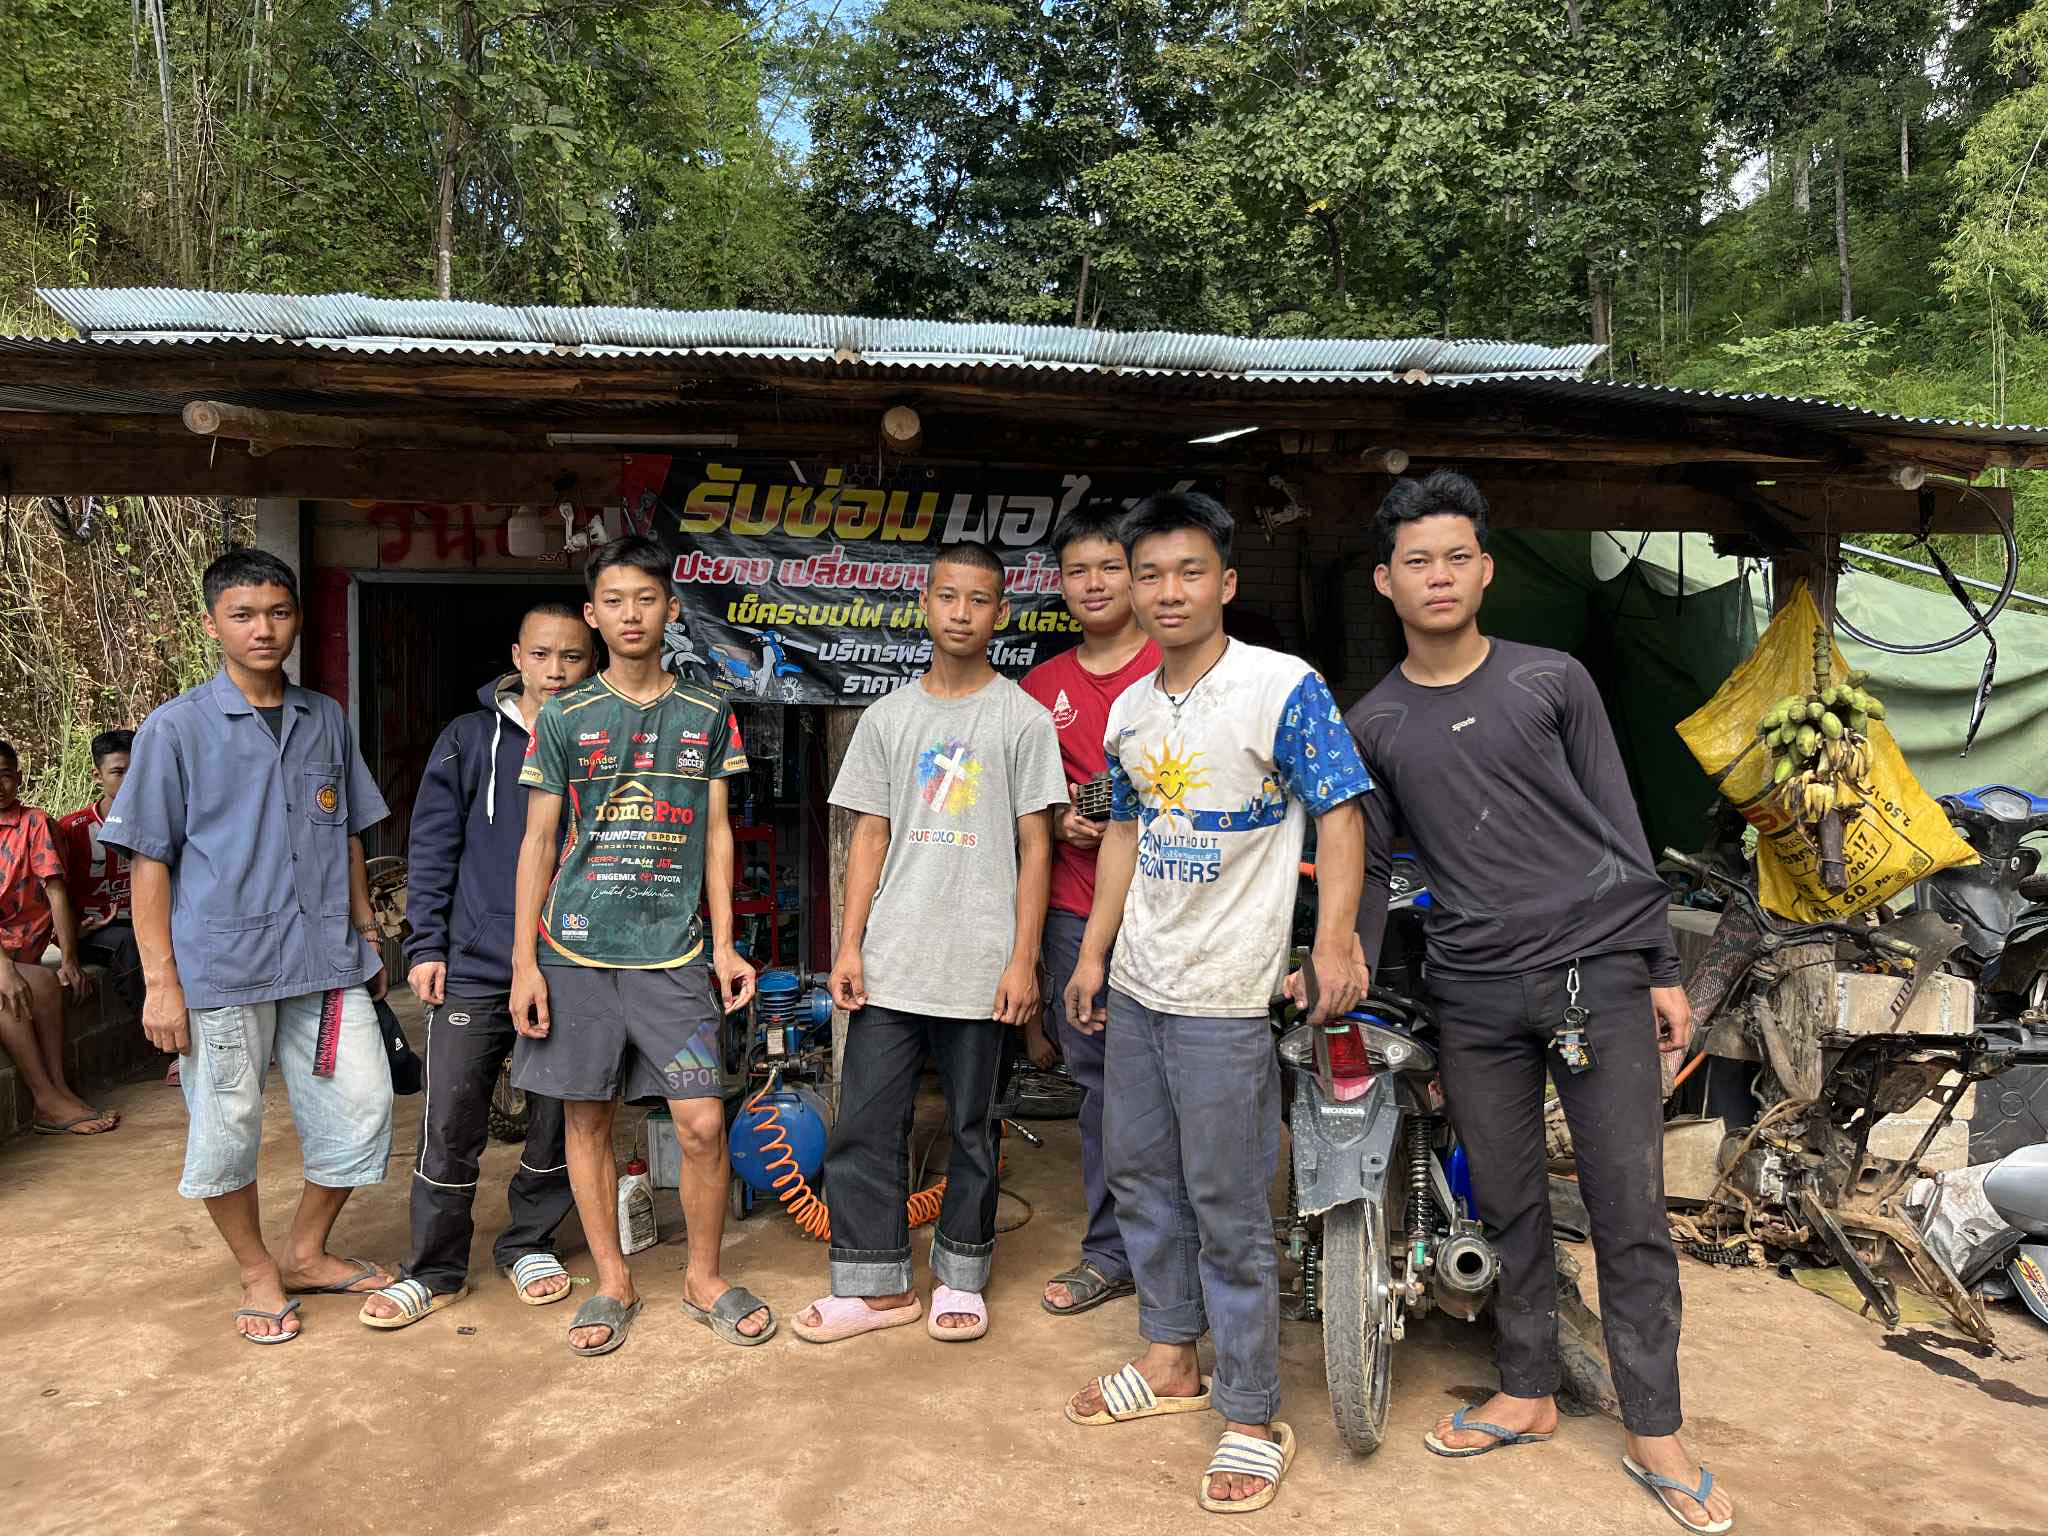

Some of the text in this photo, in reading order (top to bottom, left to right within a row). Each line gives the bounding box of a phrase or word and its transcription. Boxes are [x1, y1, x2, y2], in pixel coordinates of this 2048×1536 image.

[588, 830, 648, 842] THUNDER
[596, 872, 681, 884] ENGEMIX TOYOTA
[1320, 1106, 1365, 1115] HONDA
